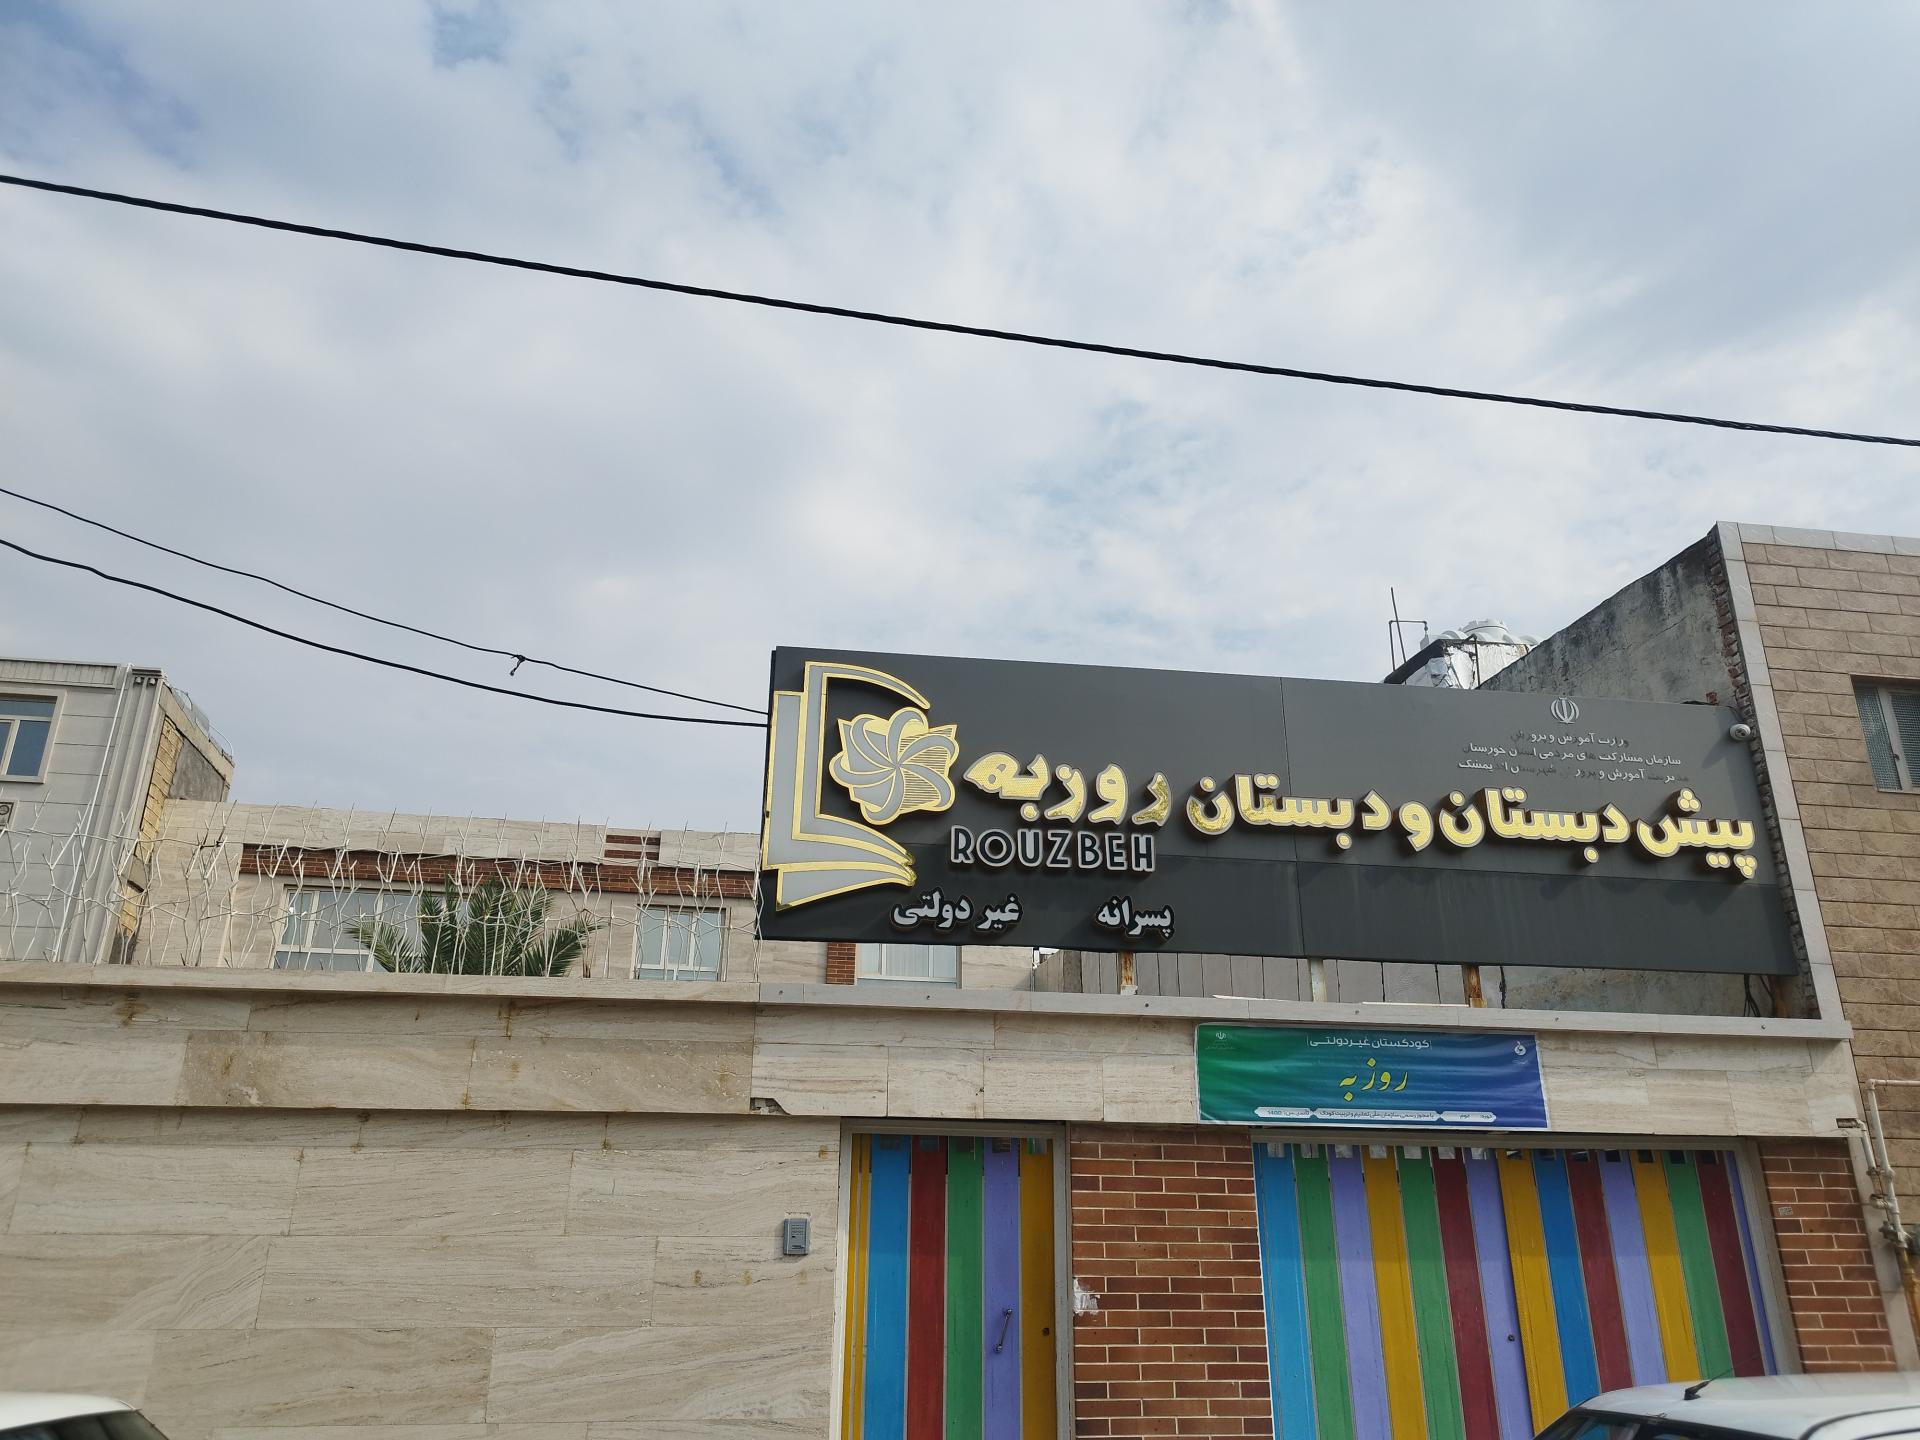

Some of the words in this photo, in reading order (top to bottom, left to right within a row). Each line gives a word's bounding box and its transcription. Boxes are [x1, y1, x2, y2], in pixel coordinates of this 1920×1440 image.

[962, 751, 1172, 827] روزبه
[1599, 769, 1605, 780] و
[1186, 771, 1393, 851] دبستان
[1401, 799, 1435, 852] و
[1439, 785, 1630, 864] دبستان
[1636, 779, 1757, 880] پیش
[950, 824, 1156, 873] ROUZBEH
[892, 886, 973, 931] دولتی
[976, 893, 1024, 931] غیر
[1096, 896, 1175, 938] پسرانه
